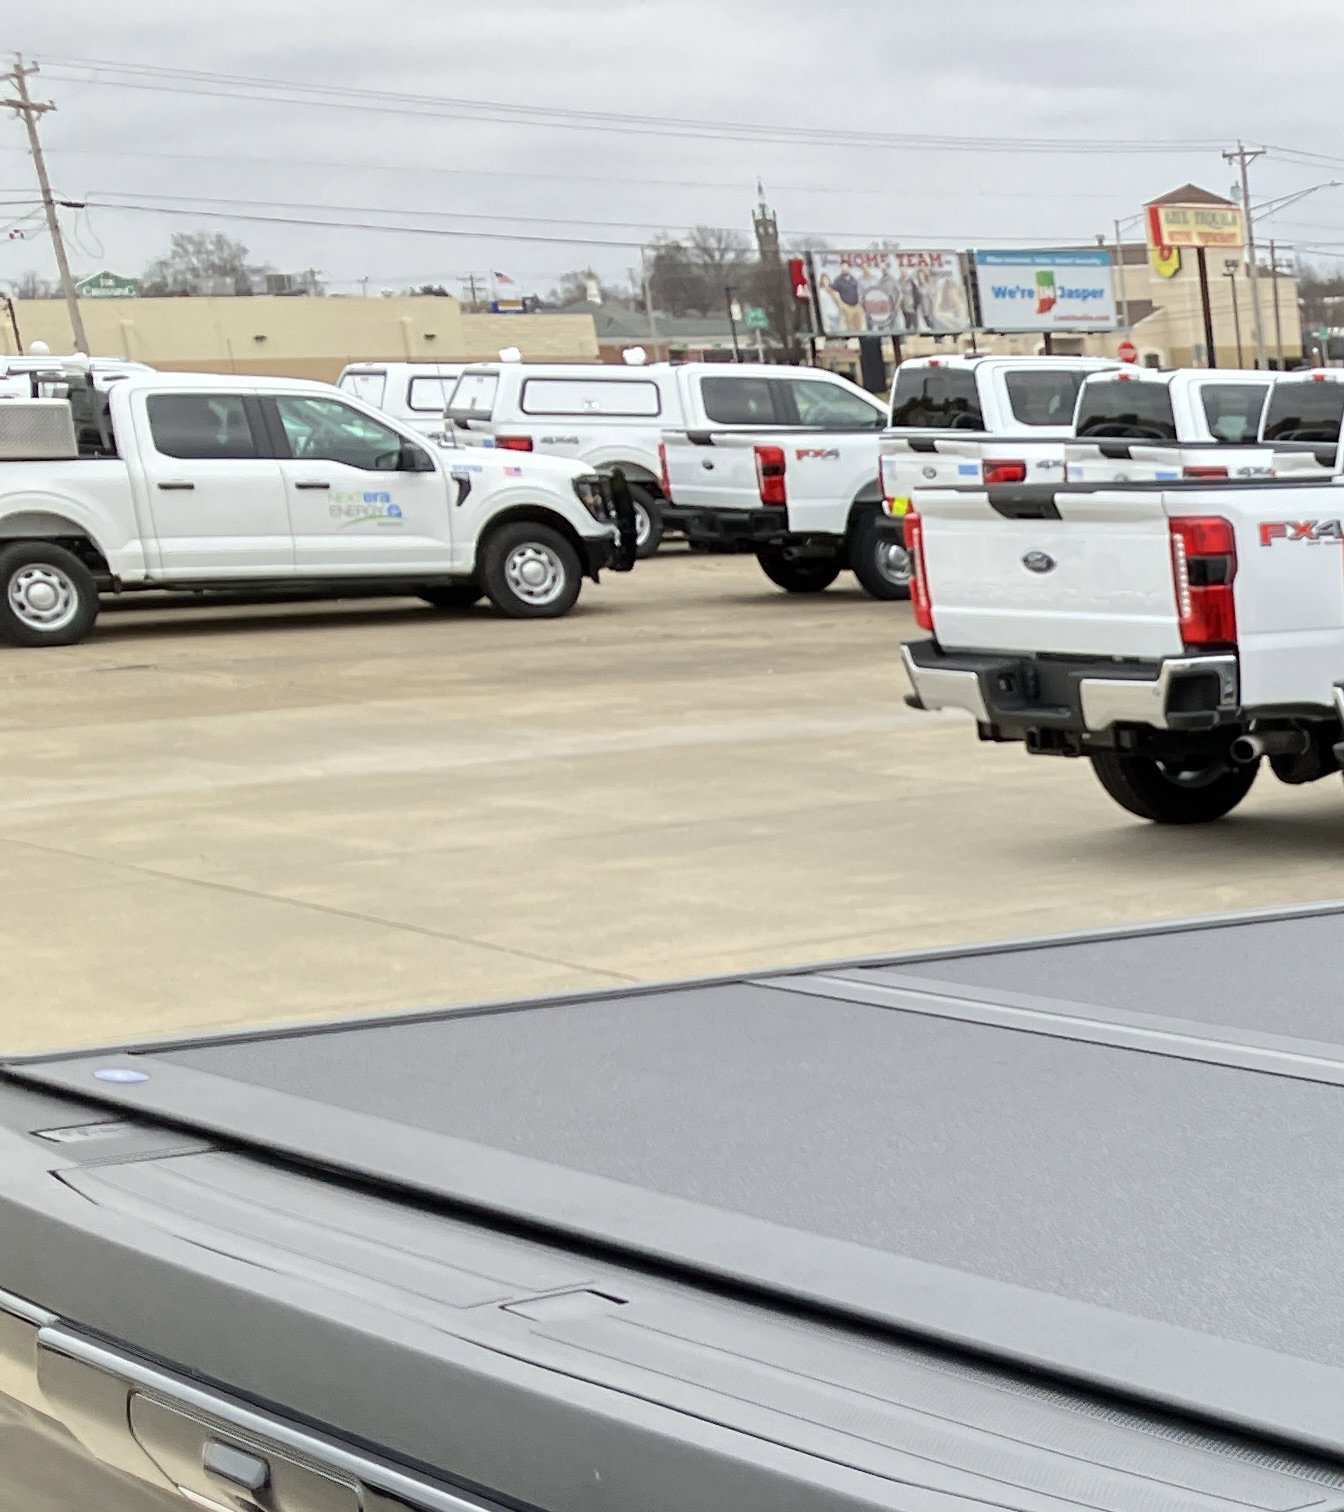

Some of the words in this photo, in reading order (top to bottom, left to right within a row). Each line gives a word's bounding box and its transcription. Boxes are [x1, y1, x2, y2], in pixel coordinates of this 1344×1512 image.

[896, 253, 944, 268] TEAM
[991, 286, 1035, 299] We're
[1057, 286, 1104, 301] Jasper
[1259, 519, 1344, 546] FX4
